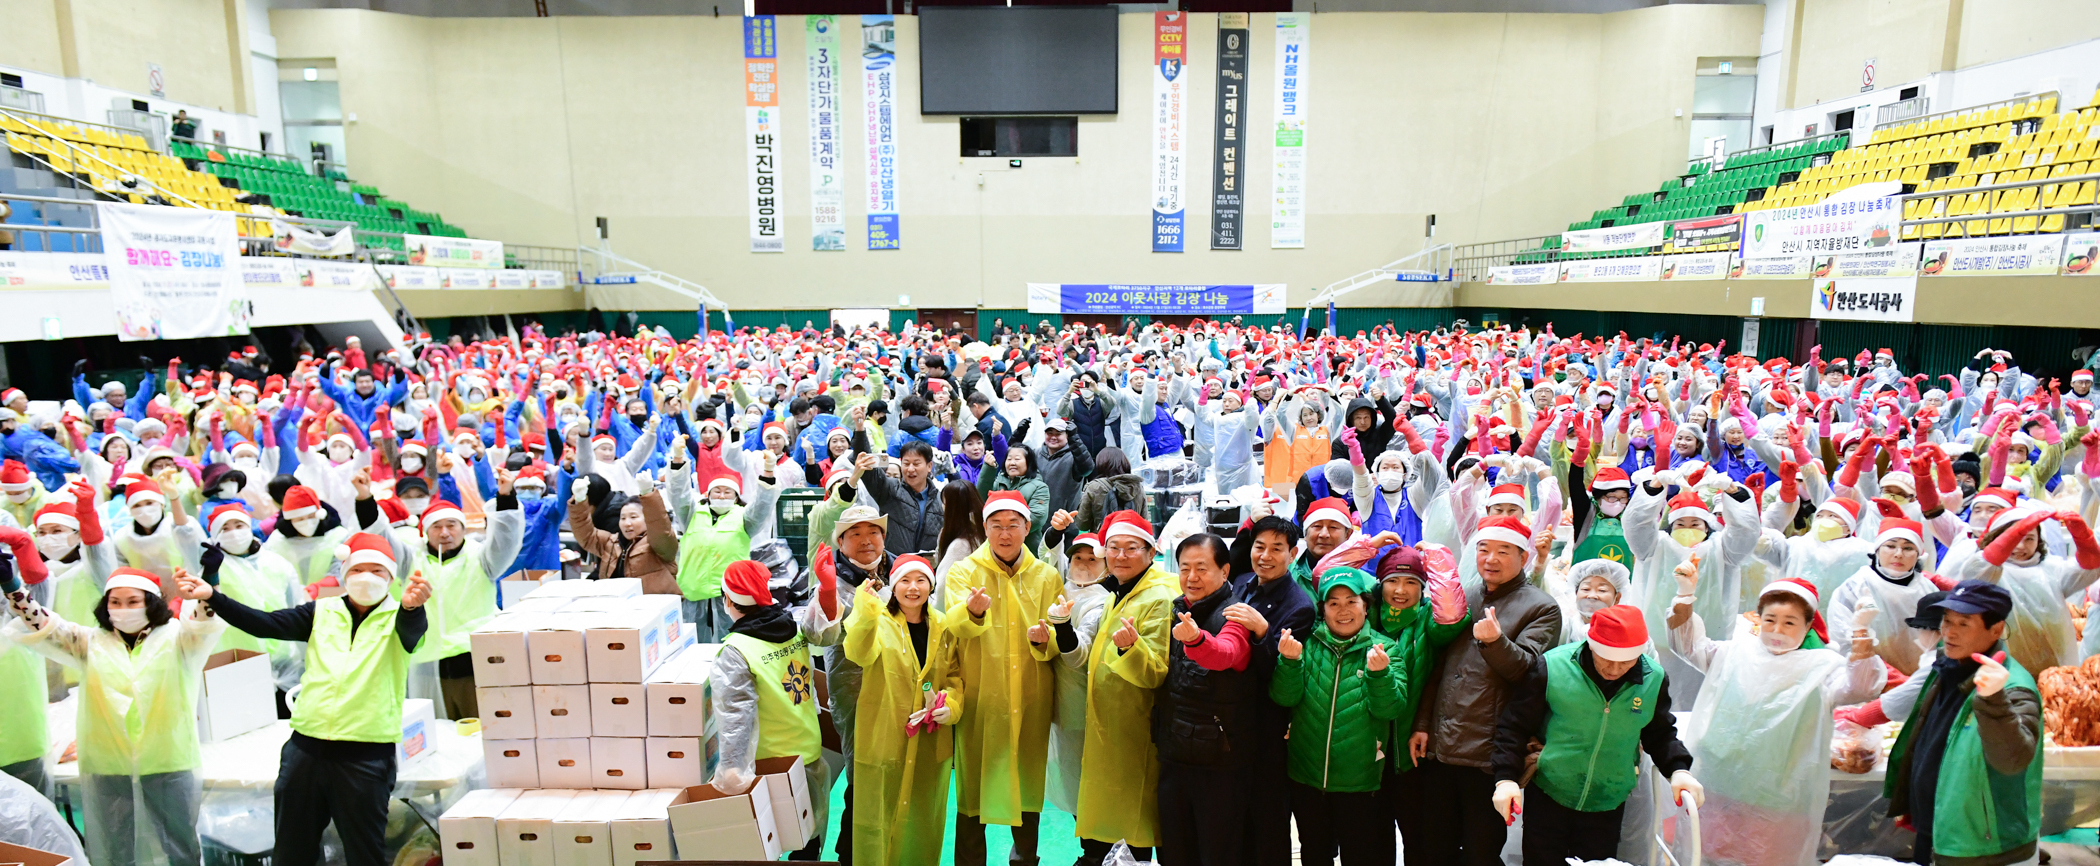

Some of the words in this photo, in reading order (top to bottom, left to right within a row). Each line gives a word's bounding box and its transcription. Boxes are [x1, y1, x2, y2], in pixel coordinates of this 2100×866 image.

[1160, 34, 1182, 42] CCTV
[1282, 44, 1299, 115] NH올원뱅크
[1171, 83, 1180, 151] 무인경비시스템
[1224, 85, 1238, 140] 그레이트
[1170, 156, 1179, 180] 24시간
[1222, 147, 1235, 191] 컨벤션
[755, 134, 775, 236] 박진영병원
[1169, 185, 1178, 210] 대기중
[815, 215, 837, 223] 9216
[1772, 208, 1798, 221] 2024년
[1800, 205, 1821, 219] 안산시
[1824, 203, 1838, 217] 통합
[1841, 201, 1856, 215] 김장
[1157, 225, 1180, 234] 1666
[1157, 235, 1178, 244] 2112
[1782, 240, 1803, 253] 안산시
[1806, 236, 1860, 251] 지역자율방재단
[1997, 255, 2032, 270] 안산도시공사
[1085, 292, 1118, 303] 2024
[1122, 292, 1171, 305] 이웃사랑
[1175, 292, 1201, 305] 김장
[1204, 292, 1229, 305] 나눔
[1837, 291, 1902, 312] 안산도시공사
